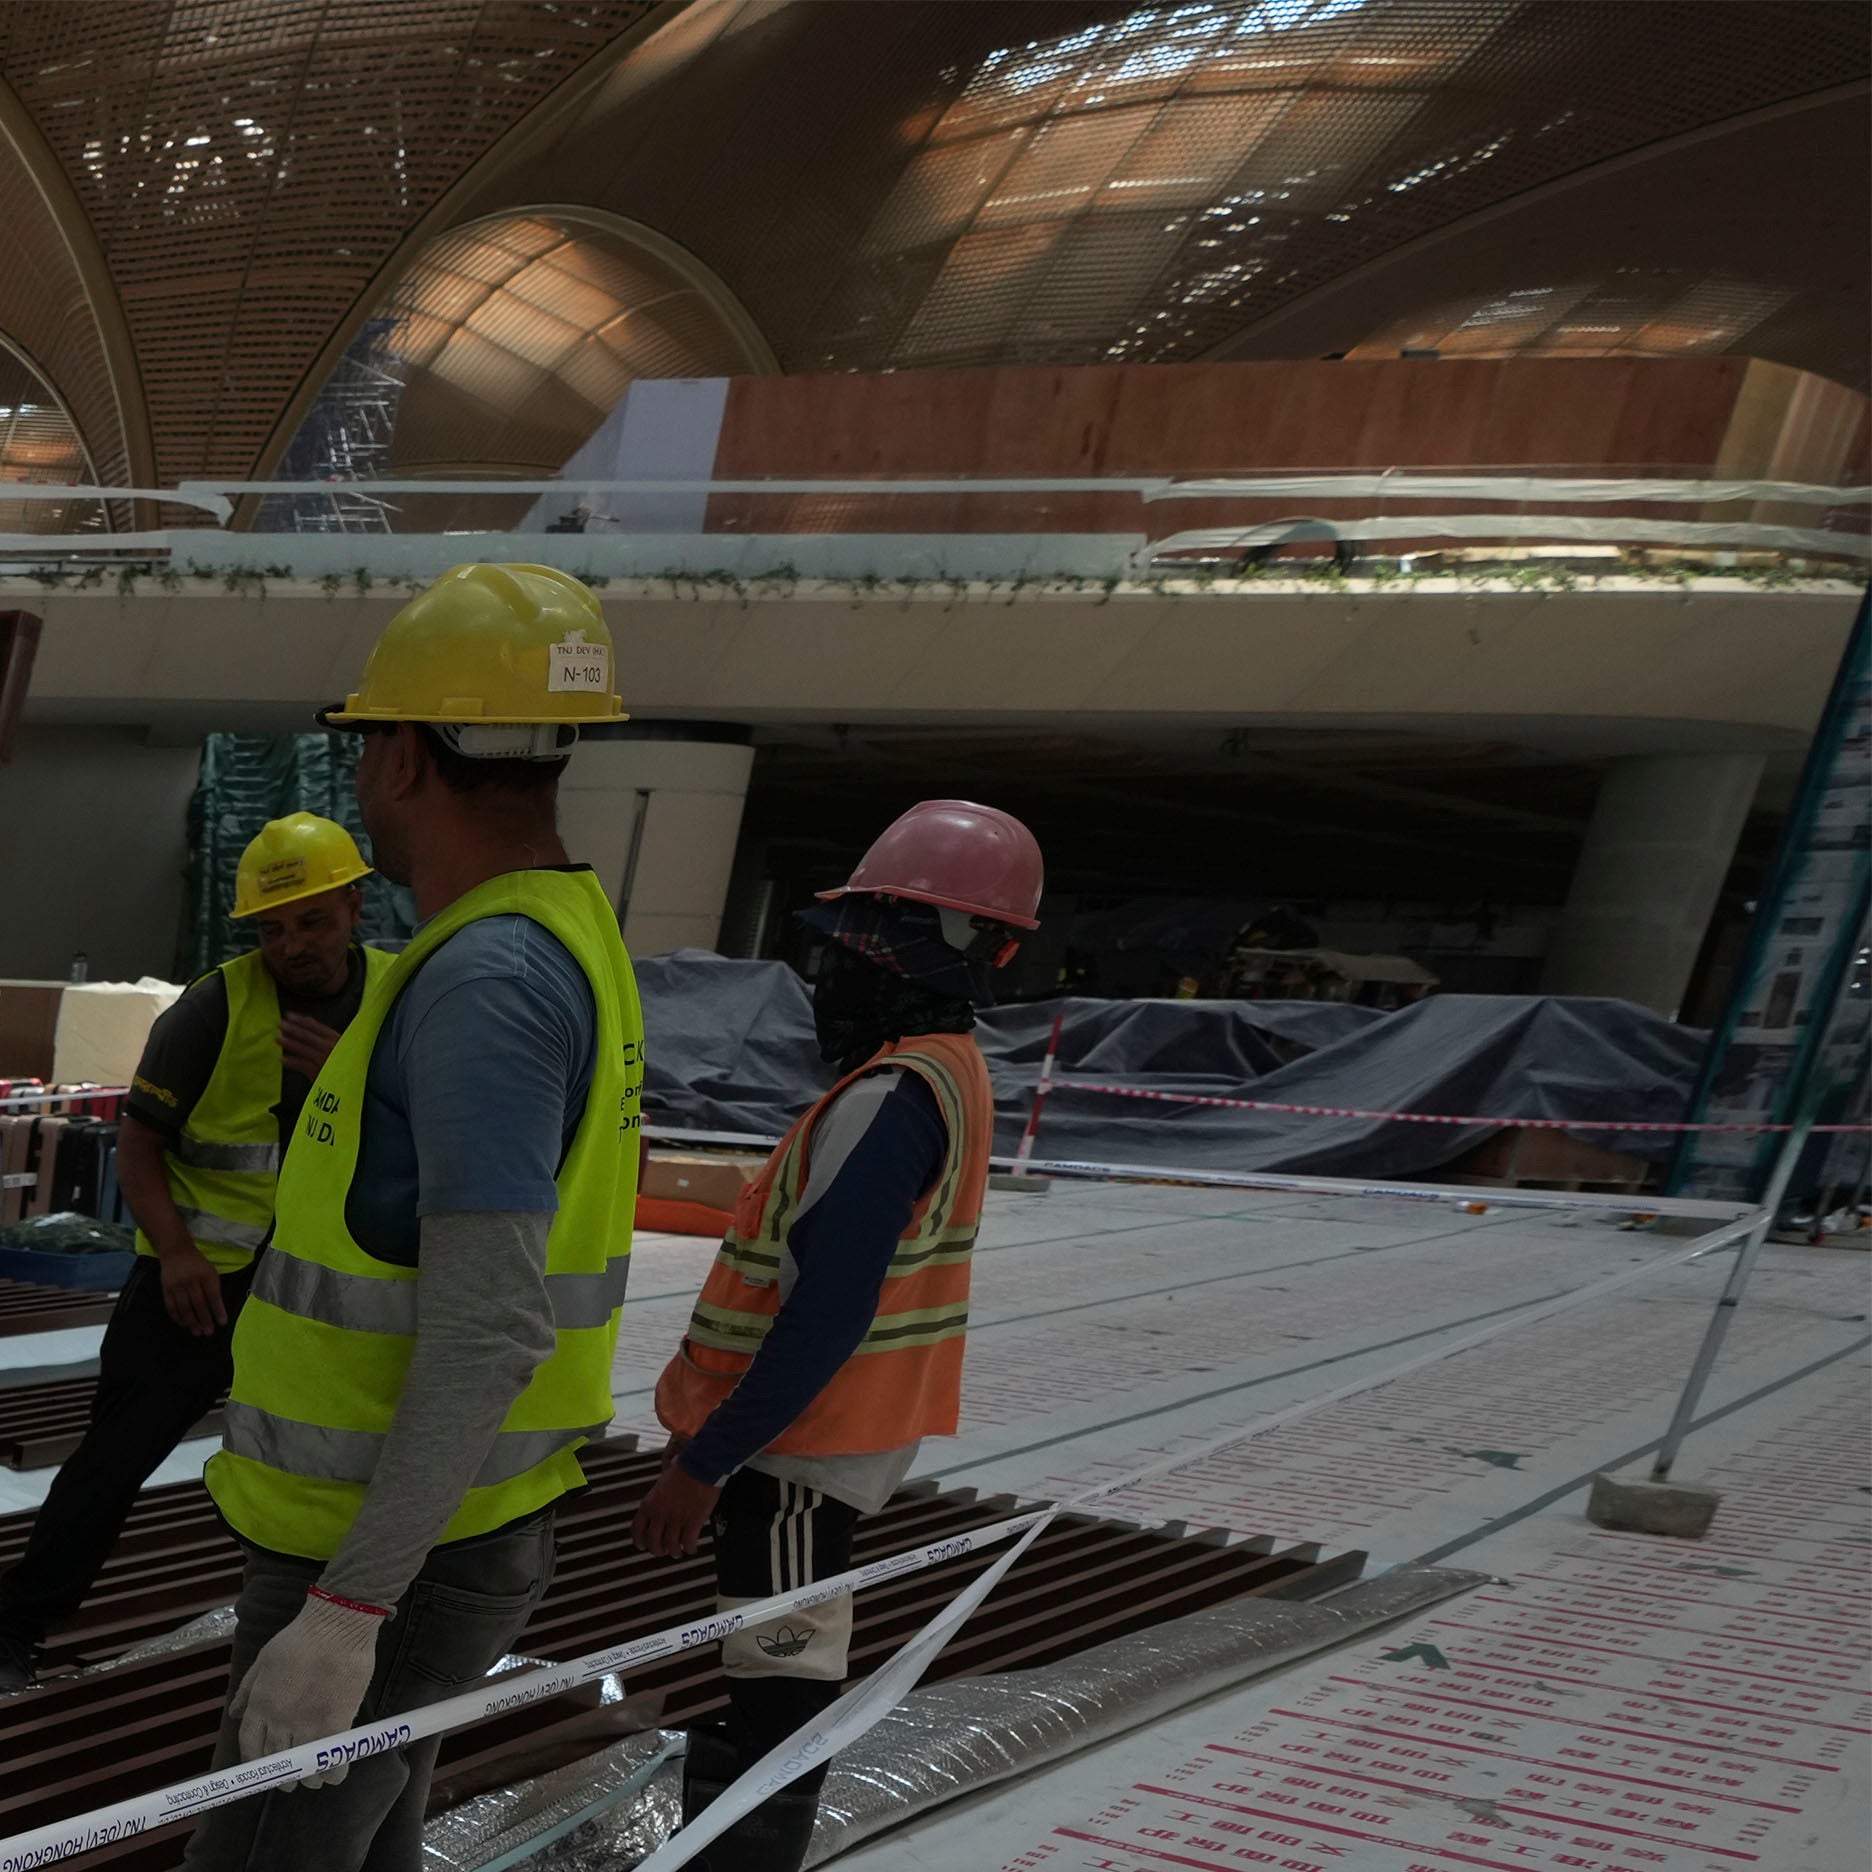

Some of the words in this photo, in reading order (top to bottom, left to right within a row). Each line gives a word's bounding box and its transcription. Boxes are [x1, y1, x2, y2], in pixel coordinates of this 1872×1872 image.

[563, 665, 601, 683] N-103
[675, 1612, 745, 1648] CAMDACS
[312, 1722, 414, 1772] CAMDACS
[82, 1820, 125, 1849] (DEV)
[119, 1813, 149, 1837] TNJ
